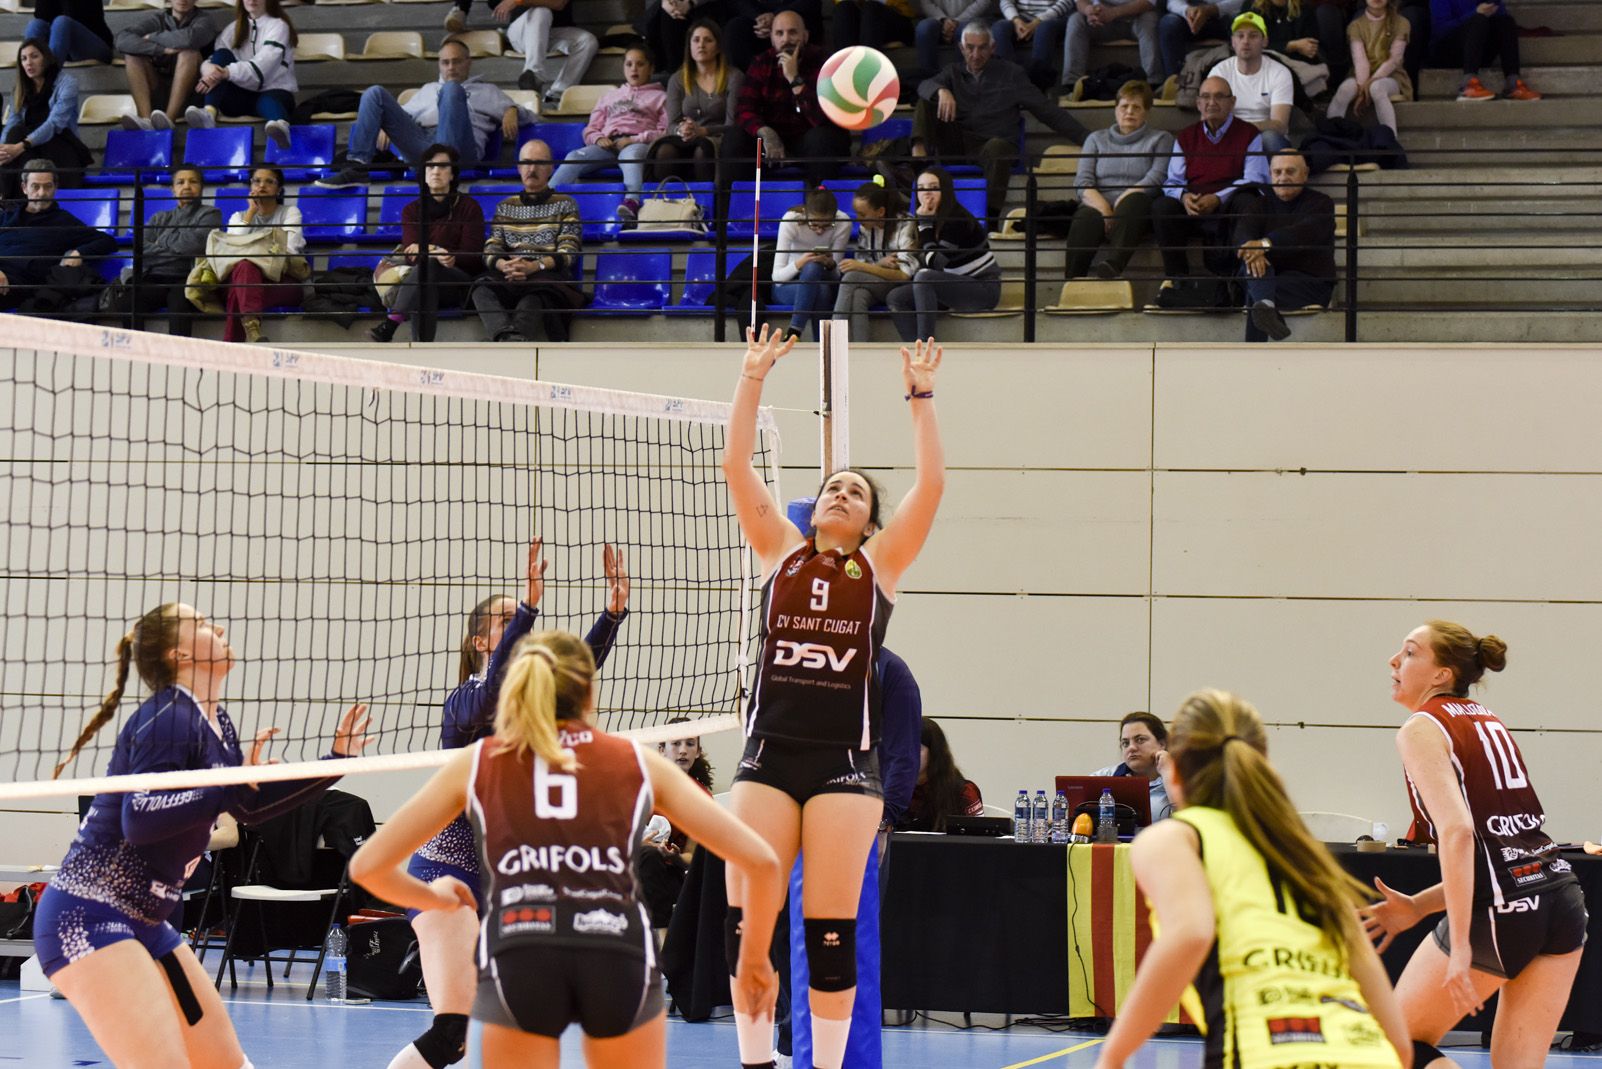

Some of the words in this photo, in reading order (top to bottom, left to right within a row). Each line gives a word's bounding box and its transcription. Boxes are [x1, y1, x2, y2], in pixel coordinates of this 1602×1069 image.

[810, 577, 829, 612] 9
[777, 614, 790, 629] CV
[793, 616, 822, 632] SANT
[823, 620, 861, 635] CUGAT
[773, 640, 857, 672] DSV
[1474, 720, 1528, 790] 10
[533, 748, 577, 819] 6
[497, 844, 625, 875] GRIFOLS
[1497, 894, 1540, 914] DSV
